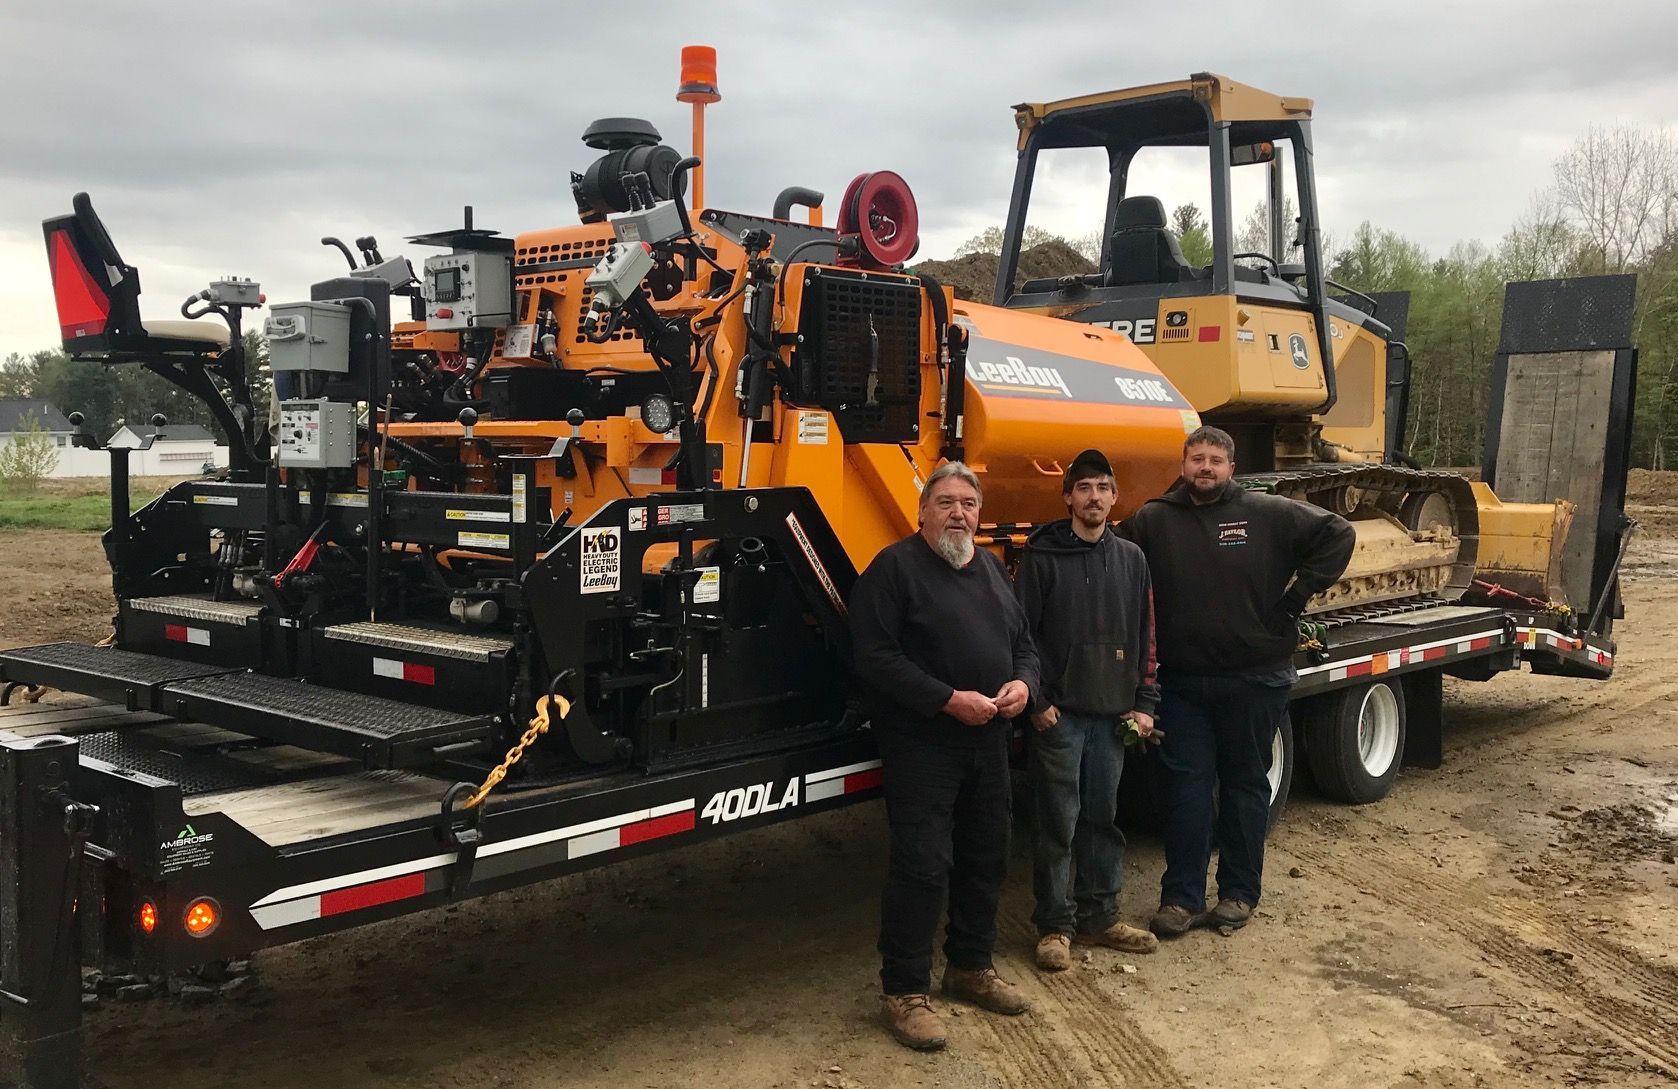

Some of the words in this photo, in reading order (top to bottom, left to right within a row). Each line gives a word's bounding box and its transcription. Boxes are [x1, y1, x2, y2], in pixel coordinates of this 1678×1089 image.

[965, 356, 1072, 398] LeeBoy
[1114, 376, 1174, 402] 8510E
[583, 558, 618, 567] ELECTRIC
[583, 565, 618, 575] LEGEND
[583, 574, 618, 588] LeeBoy
[701, 776, 799, 825] 40DLA
[160, 833, 213, 850] AMBROSE
